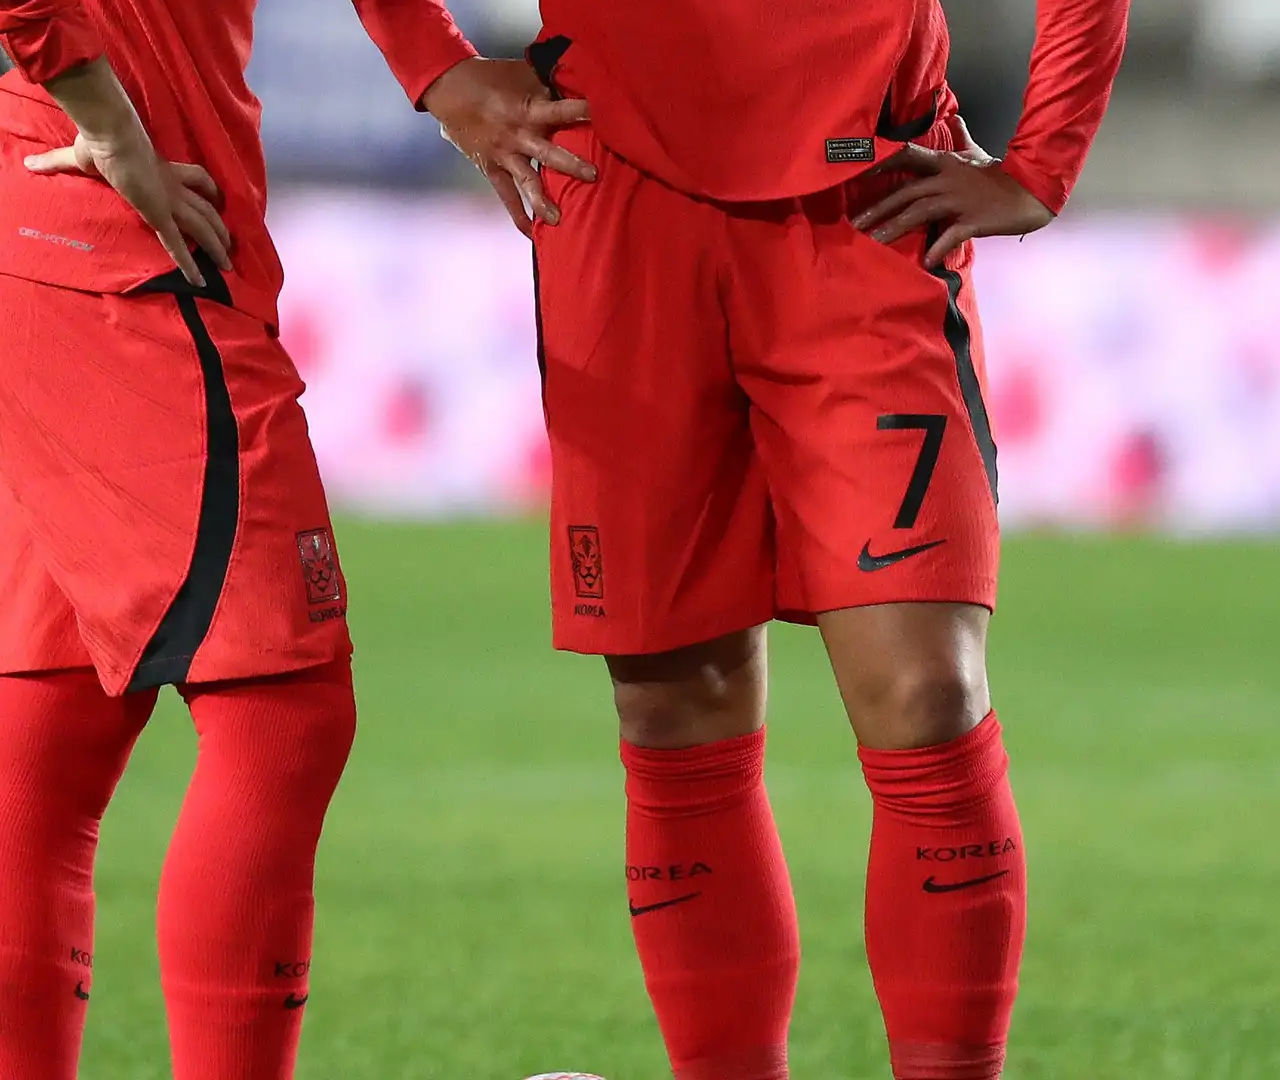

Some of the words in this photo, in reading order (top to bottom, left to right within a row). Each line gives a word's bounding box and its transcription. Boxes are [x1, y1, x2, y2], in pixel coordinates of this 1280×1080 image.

[876, 413, 948, 529] 7
[574, 604, 606, 618] KOREA
[916, 837, 1016, 862] KOREA
[625, 861, 713, 881] OREA
